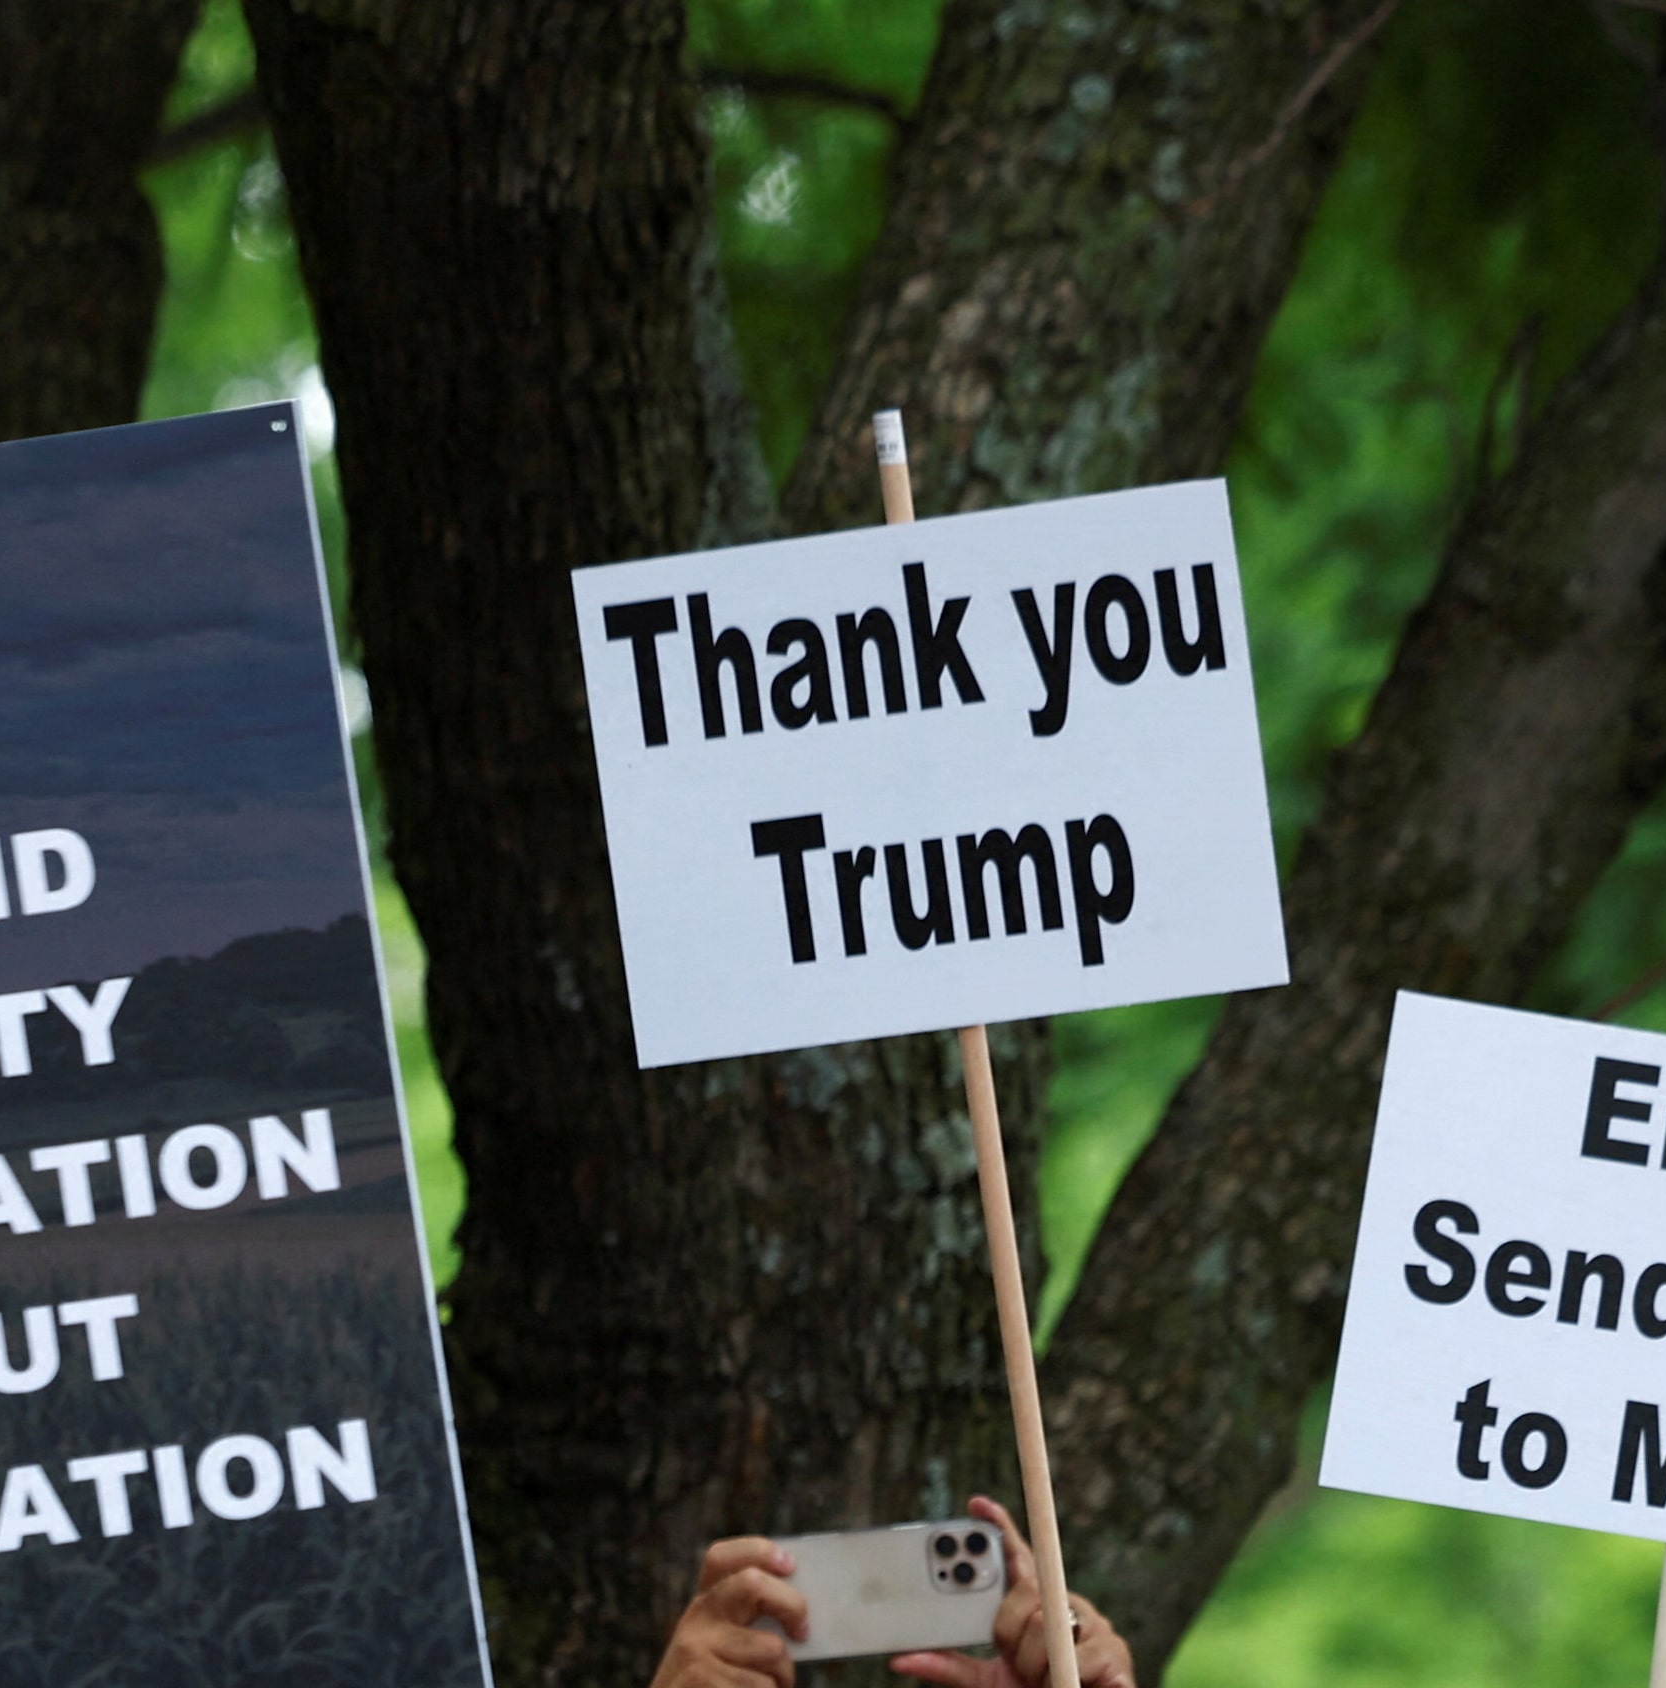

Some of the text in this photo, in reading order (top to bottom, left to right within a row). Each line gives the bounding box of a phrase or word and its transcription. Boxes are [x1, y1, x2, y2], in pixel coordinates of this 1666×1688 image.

[601, 560, 1228, 749] Thank you
[749, 812, 1136, 968] Trump
[1453, 1378, 1569, 1491] to
